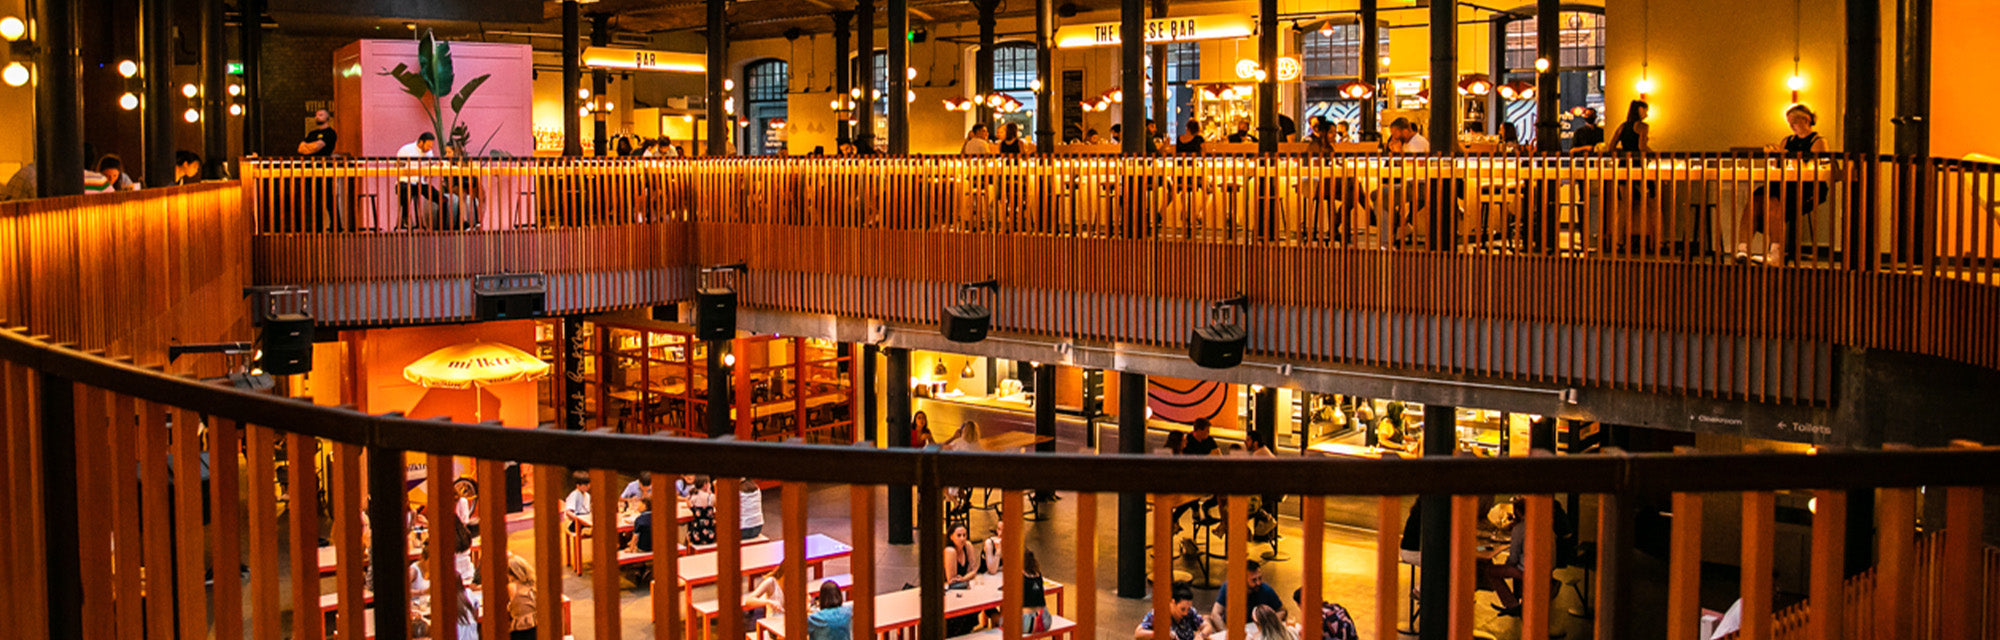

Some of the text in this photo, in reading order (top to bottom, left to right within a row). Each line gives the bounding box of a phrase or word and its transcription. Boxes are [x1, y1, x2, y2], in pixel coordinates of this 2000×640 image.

[1095, 25, 1113, 42] THE
[1171, 19, 1195, 38] BAR
[636, 52, 656, 66] BAR
[1792, 422, 1832, 435] Toilets
